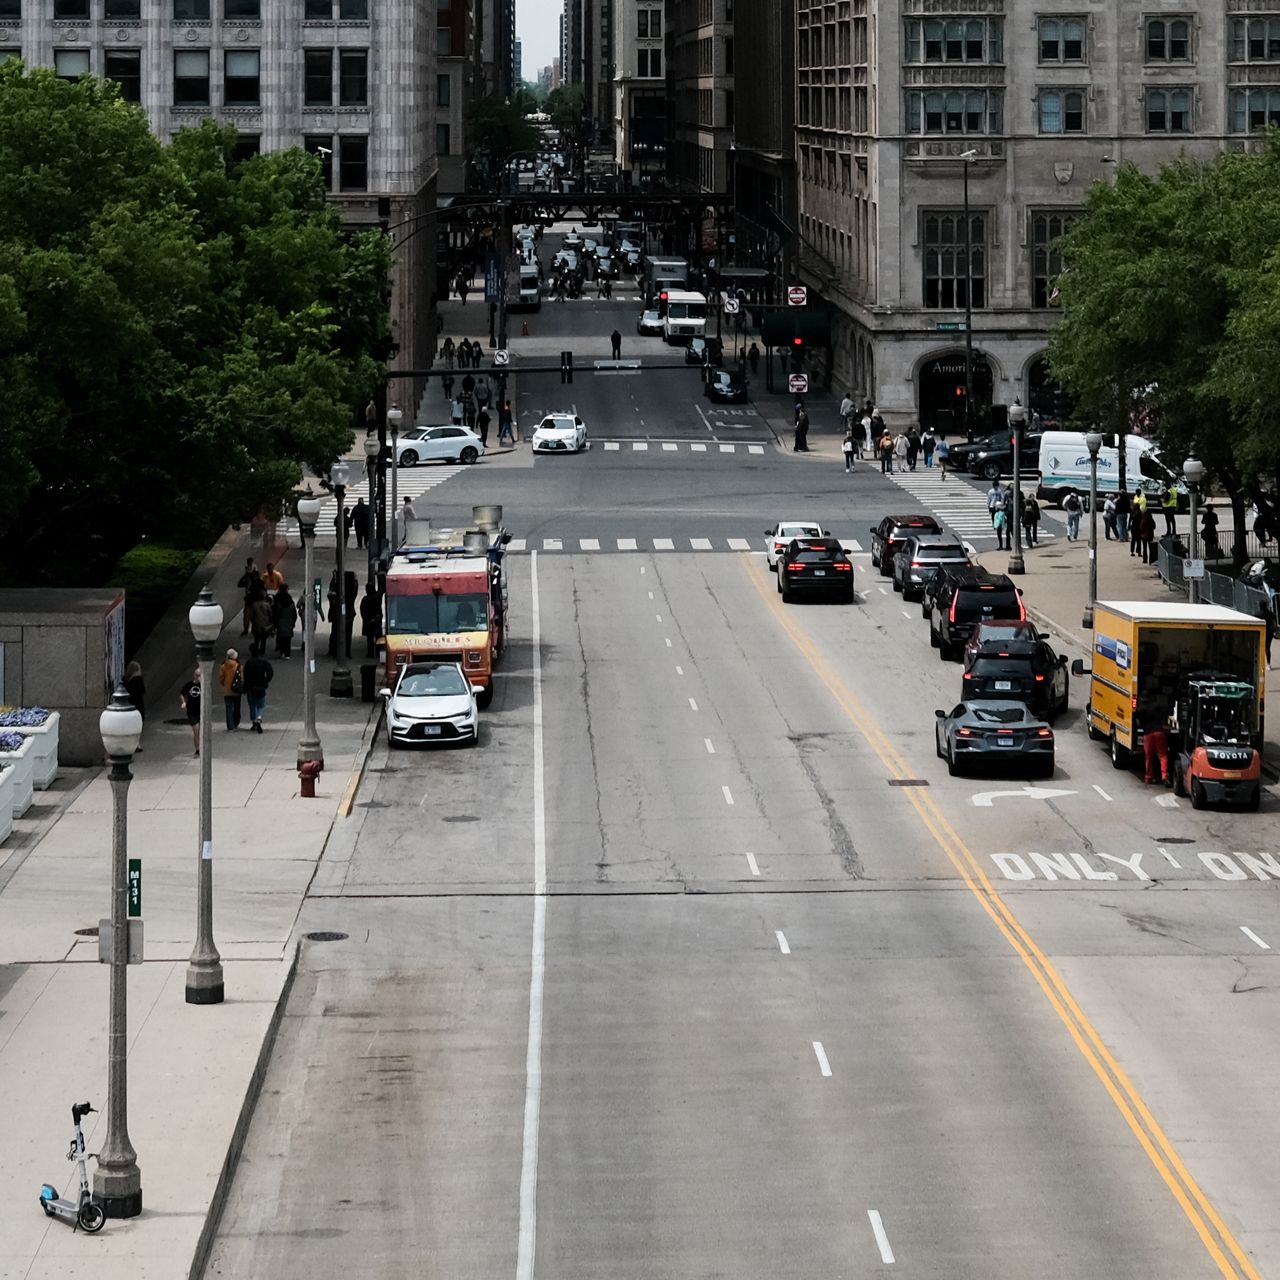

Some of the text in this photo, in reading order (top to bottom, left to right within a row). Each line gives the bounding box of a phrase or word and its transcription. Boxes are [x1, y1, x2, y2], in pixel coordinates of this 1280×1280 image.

[932, 361, 975, 373] Amori
[1213, 751, 1248, 760] TOYOTA
[990, 853, 1149, 881] ONLY
[130, 870, 140, 905] M131
